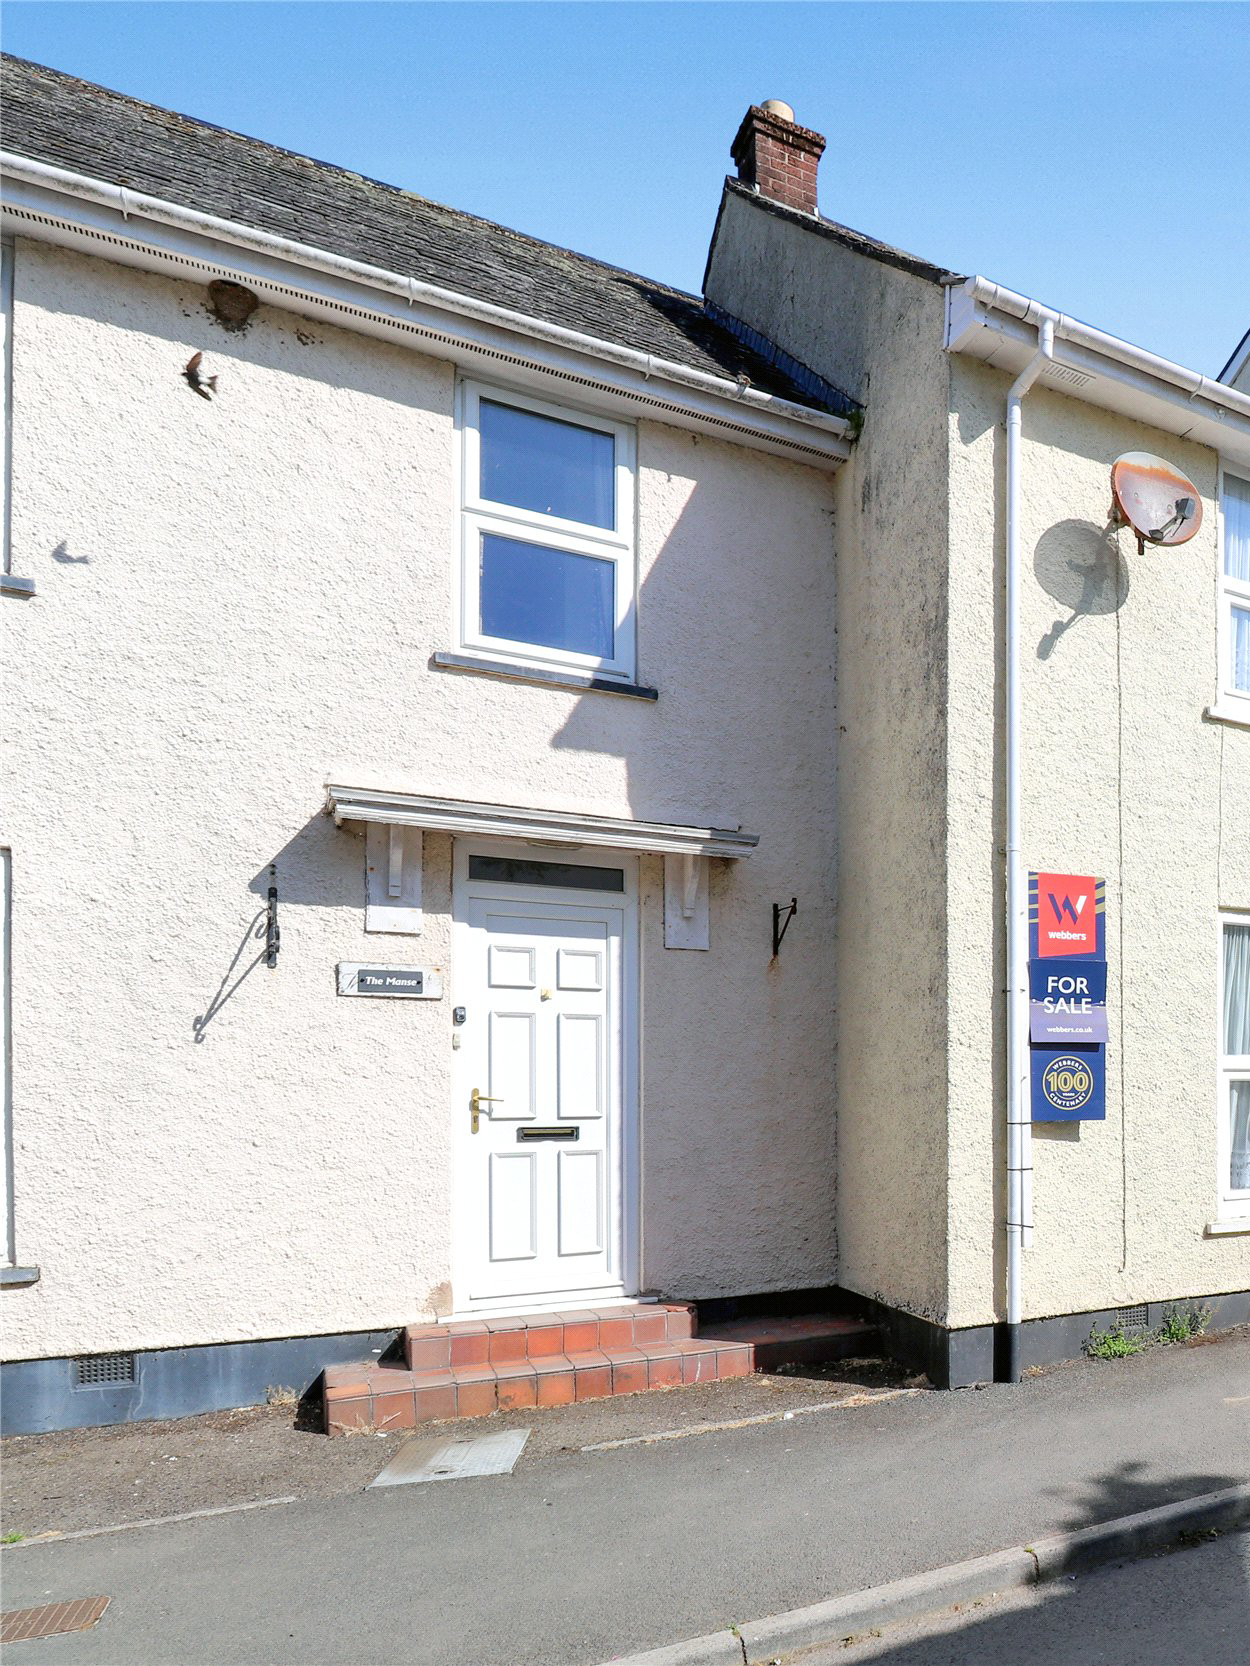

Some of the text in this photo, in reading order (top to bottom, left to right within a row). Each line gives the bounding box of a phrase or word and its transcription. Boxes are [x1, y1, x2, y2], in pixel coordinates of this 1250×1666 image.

[1047, 893, 1087, 925] W
[1047, 930, 1087, 941] webbers
[365, 976, 384, 985] The
[385, 977, 417, 987] Manse
[1047, 976, 1090, 994] FOR
[1043, 996, 1093, 1014] SALE
[1052, 1060, 1083, 1070] WEBBERS
[1046, 1071, 1089, 1092] 100
[1050, 1092, 1086, 1107] CENTENARY
